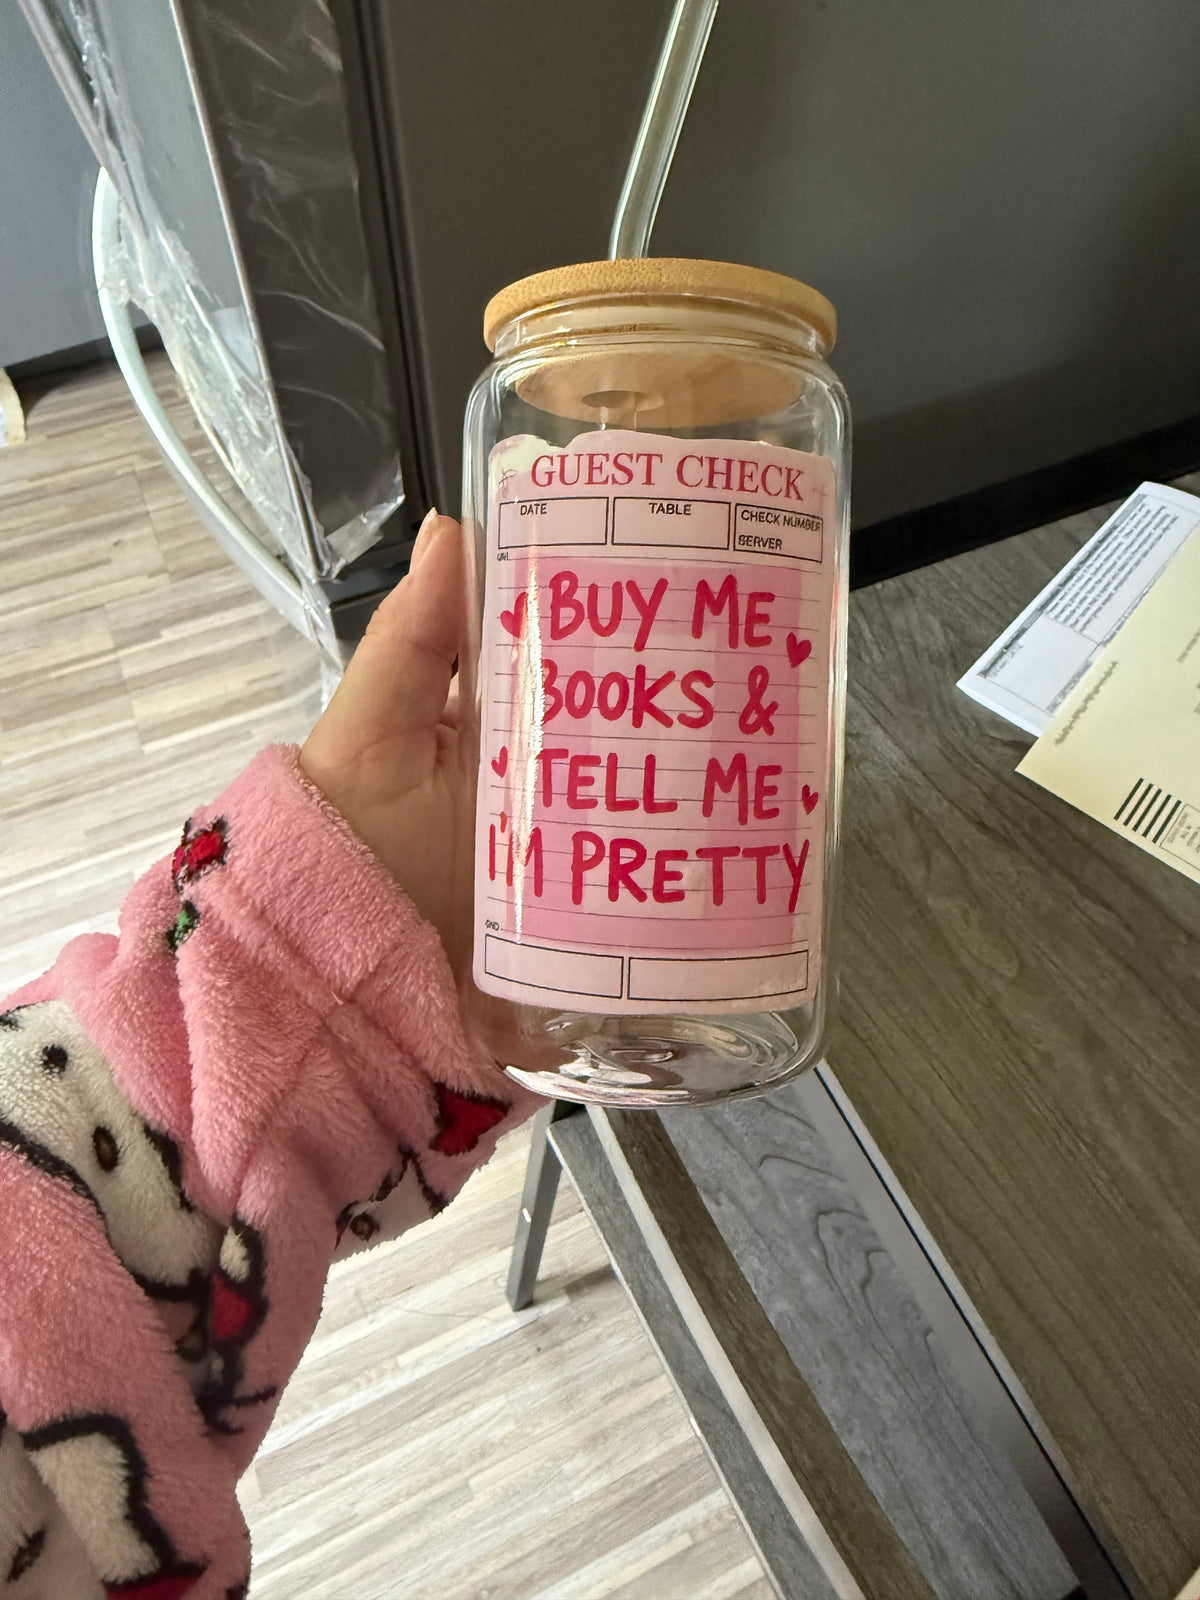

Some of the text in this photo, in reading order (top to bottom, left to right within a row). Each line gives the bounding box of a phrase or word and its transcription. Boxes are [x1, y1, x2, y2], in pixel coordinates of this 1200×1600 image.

[531, 453, 804, 501] GUEST CHECK
[520, 502, 548, 517] DATE
[649, 502, 692, 516] TABLE
[741, 509, 821, 532] CHECK NUMBER
[738, 534, 783, 550] SERVER
[549, 570, 775, 652] BUY ME
[541, 659, 779, 735] BOOKS &
[535, 748, 782, 826] TELL ME
[489, 811, 810, 913] I'M PRETTY
